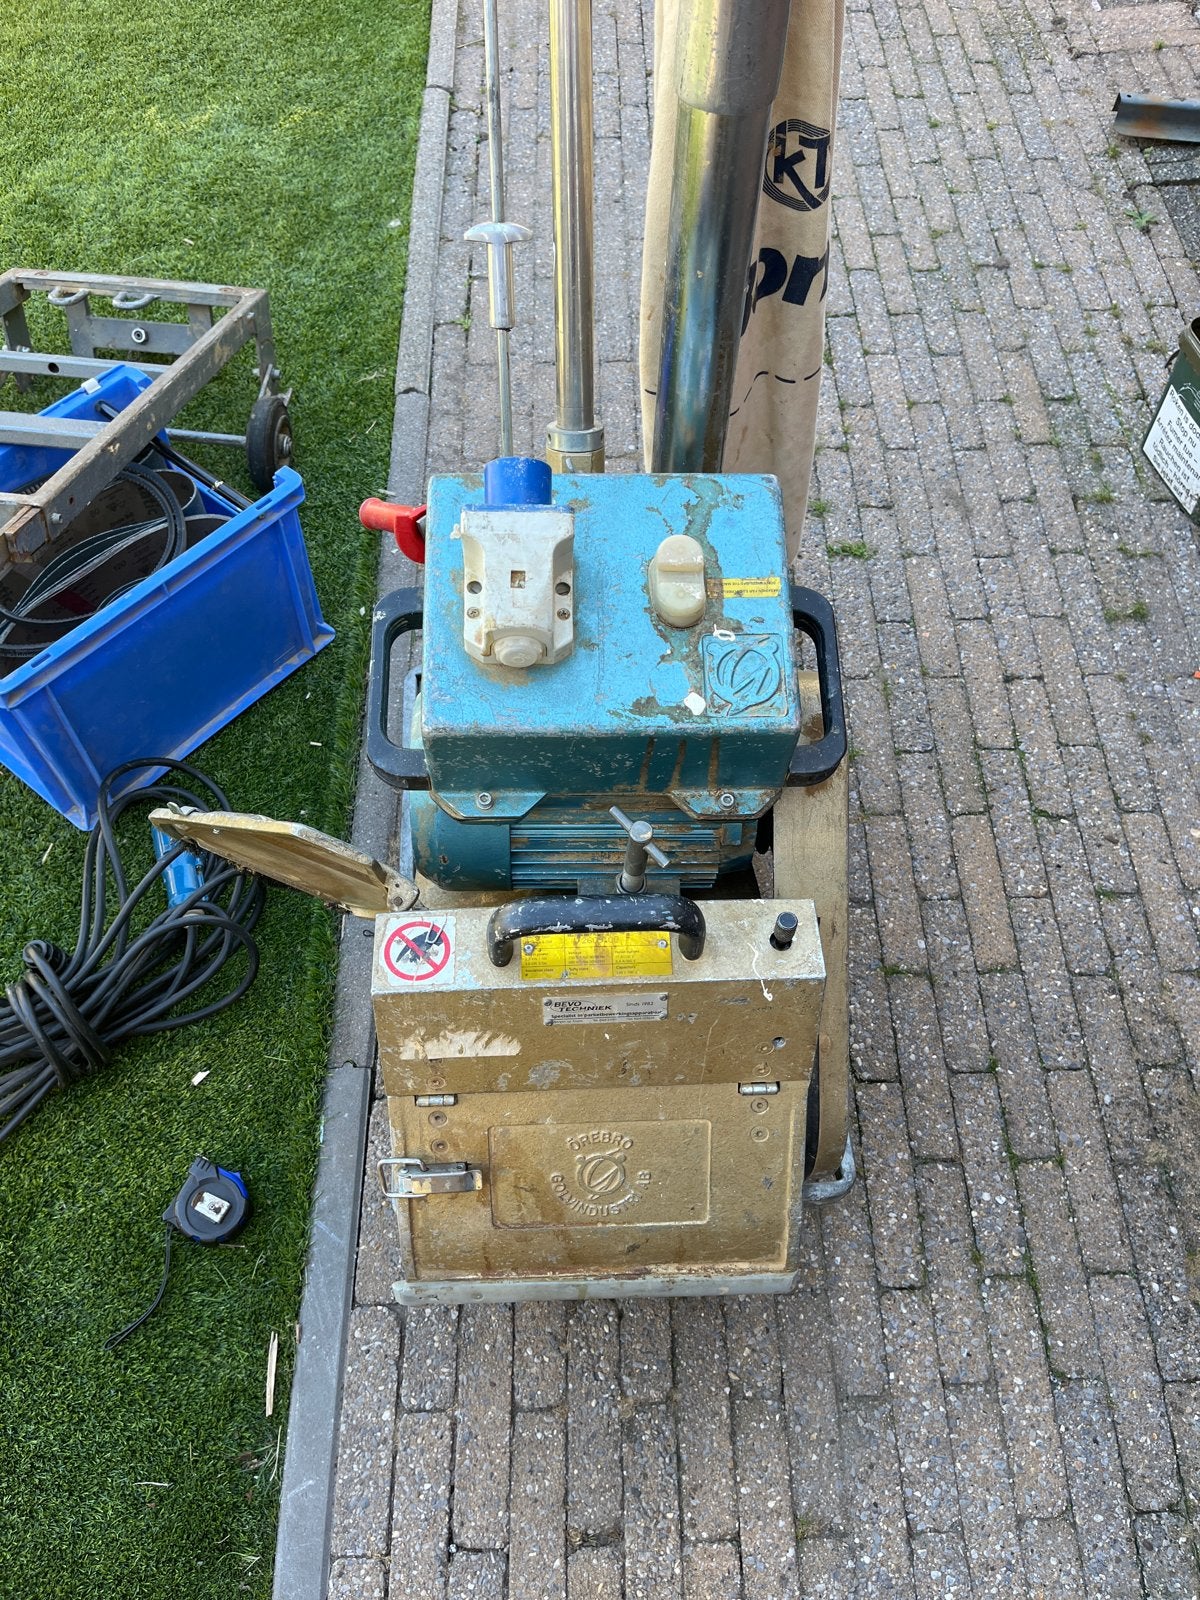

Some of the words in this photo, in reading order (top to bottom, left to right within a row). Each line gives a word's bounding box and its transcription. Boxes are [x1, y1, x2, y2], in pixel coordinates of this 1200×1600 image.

[1169, 389, 1183, 416] Roken
[1183, 413, 1189, 424] is
[1167, 419, 1182, 445] Fumer
[1175, 417, 1188, 438] Stop
[1188, 436, 1197, 448] nu
[1159, 438, 1181, 472] Rauchen
[567, 1130, 633, 1151] ÖREBRO
[635, 1169, 651, 1190] AB
